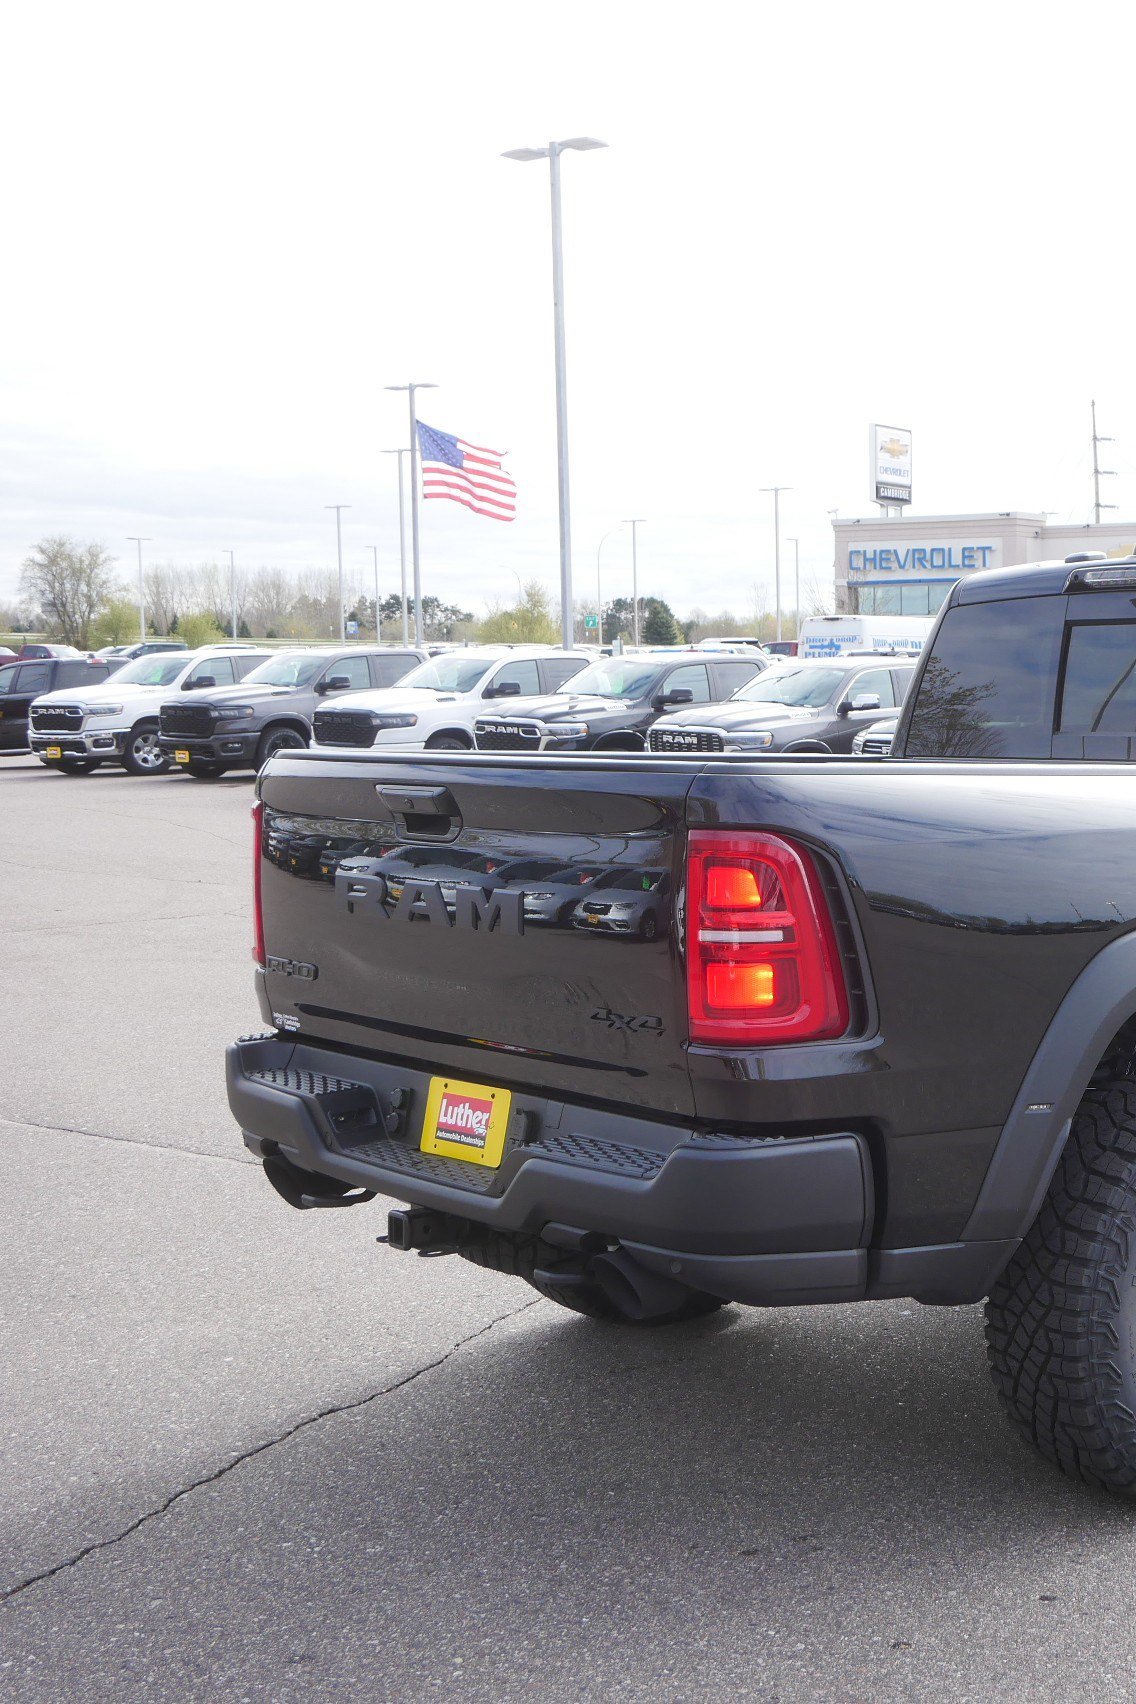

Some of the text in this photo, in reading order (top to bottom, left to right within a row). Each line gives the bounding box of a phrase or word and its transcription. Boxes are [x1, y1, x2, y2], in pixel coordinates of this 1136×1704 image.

[849, 546, 992, 571] CHEVROLET
[485, 725, 519, 734] RAM
[662, 734, 698, 744] RAM
[335, 870, 525, 936] RAM
[439, 1098, 490, 1129] Luther
